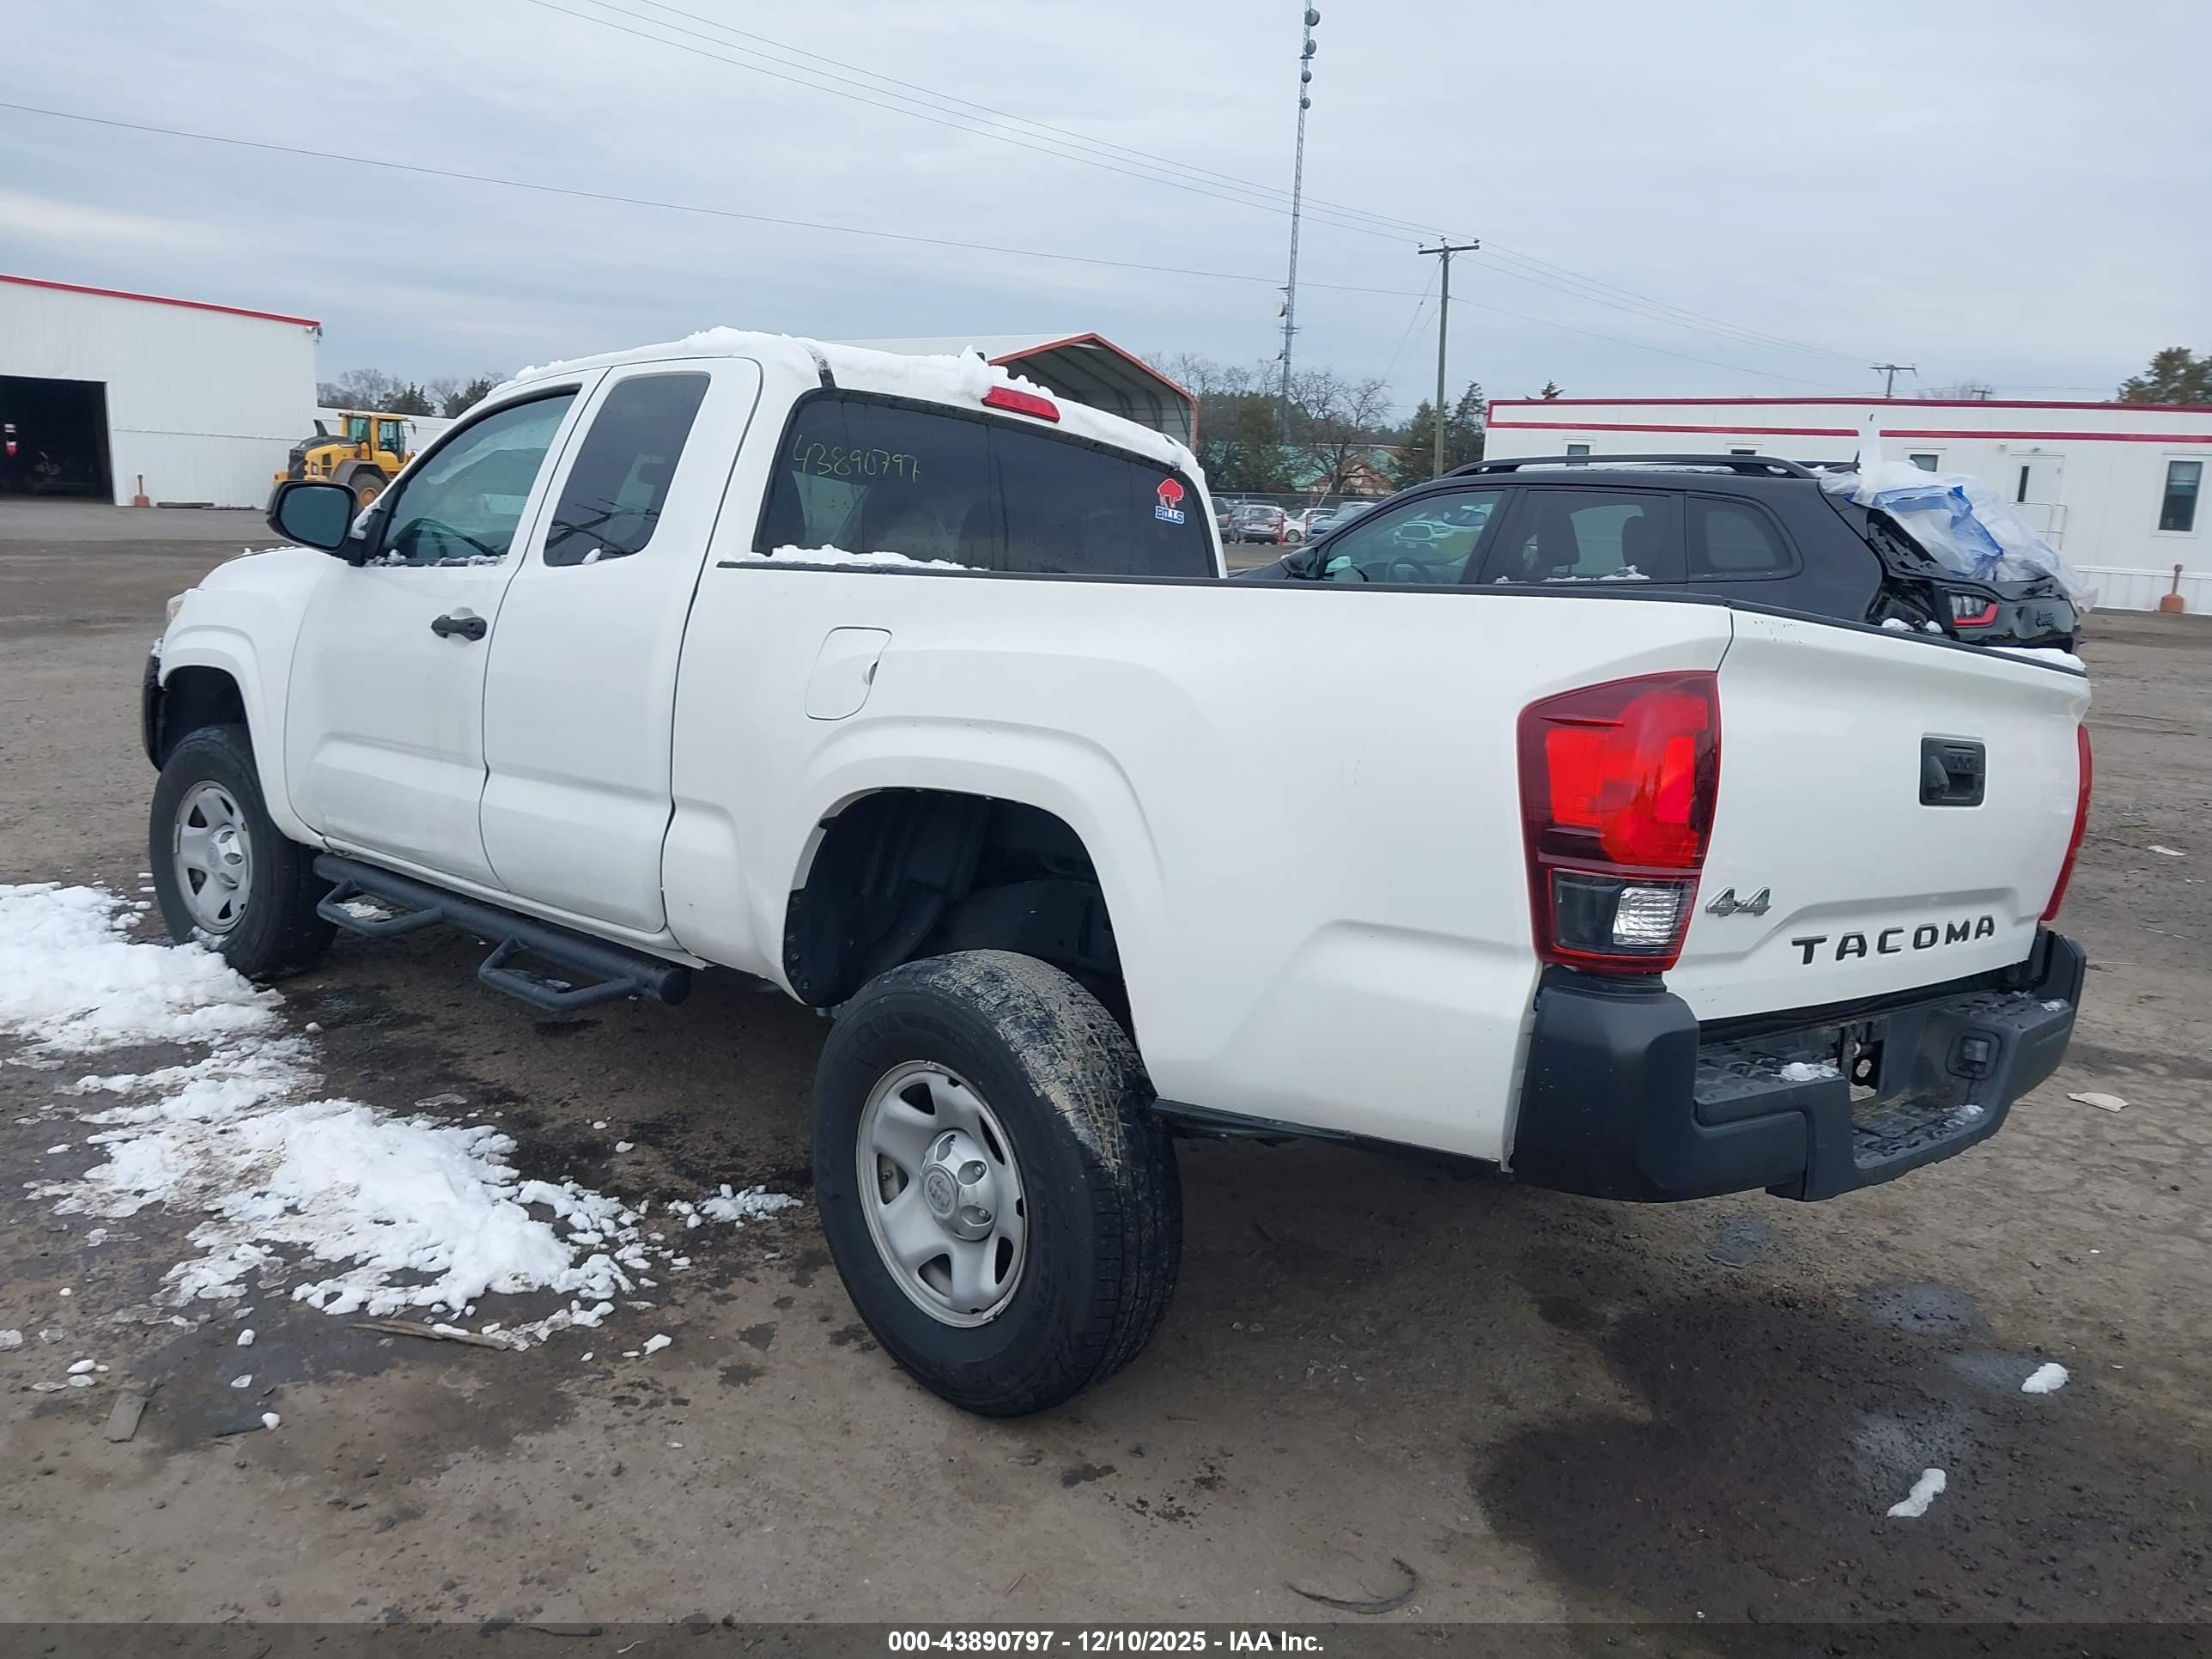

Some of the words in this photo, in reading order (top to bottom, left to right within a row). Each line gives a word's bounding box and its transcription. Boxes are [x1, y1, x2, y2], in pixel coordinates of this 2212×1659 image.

[792, 434, 921, 483] 43890797
[1156, 507, 1183, 523] BILLS
[1791, 914, 1996, 966] TACOMA
